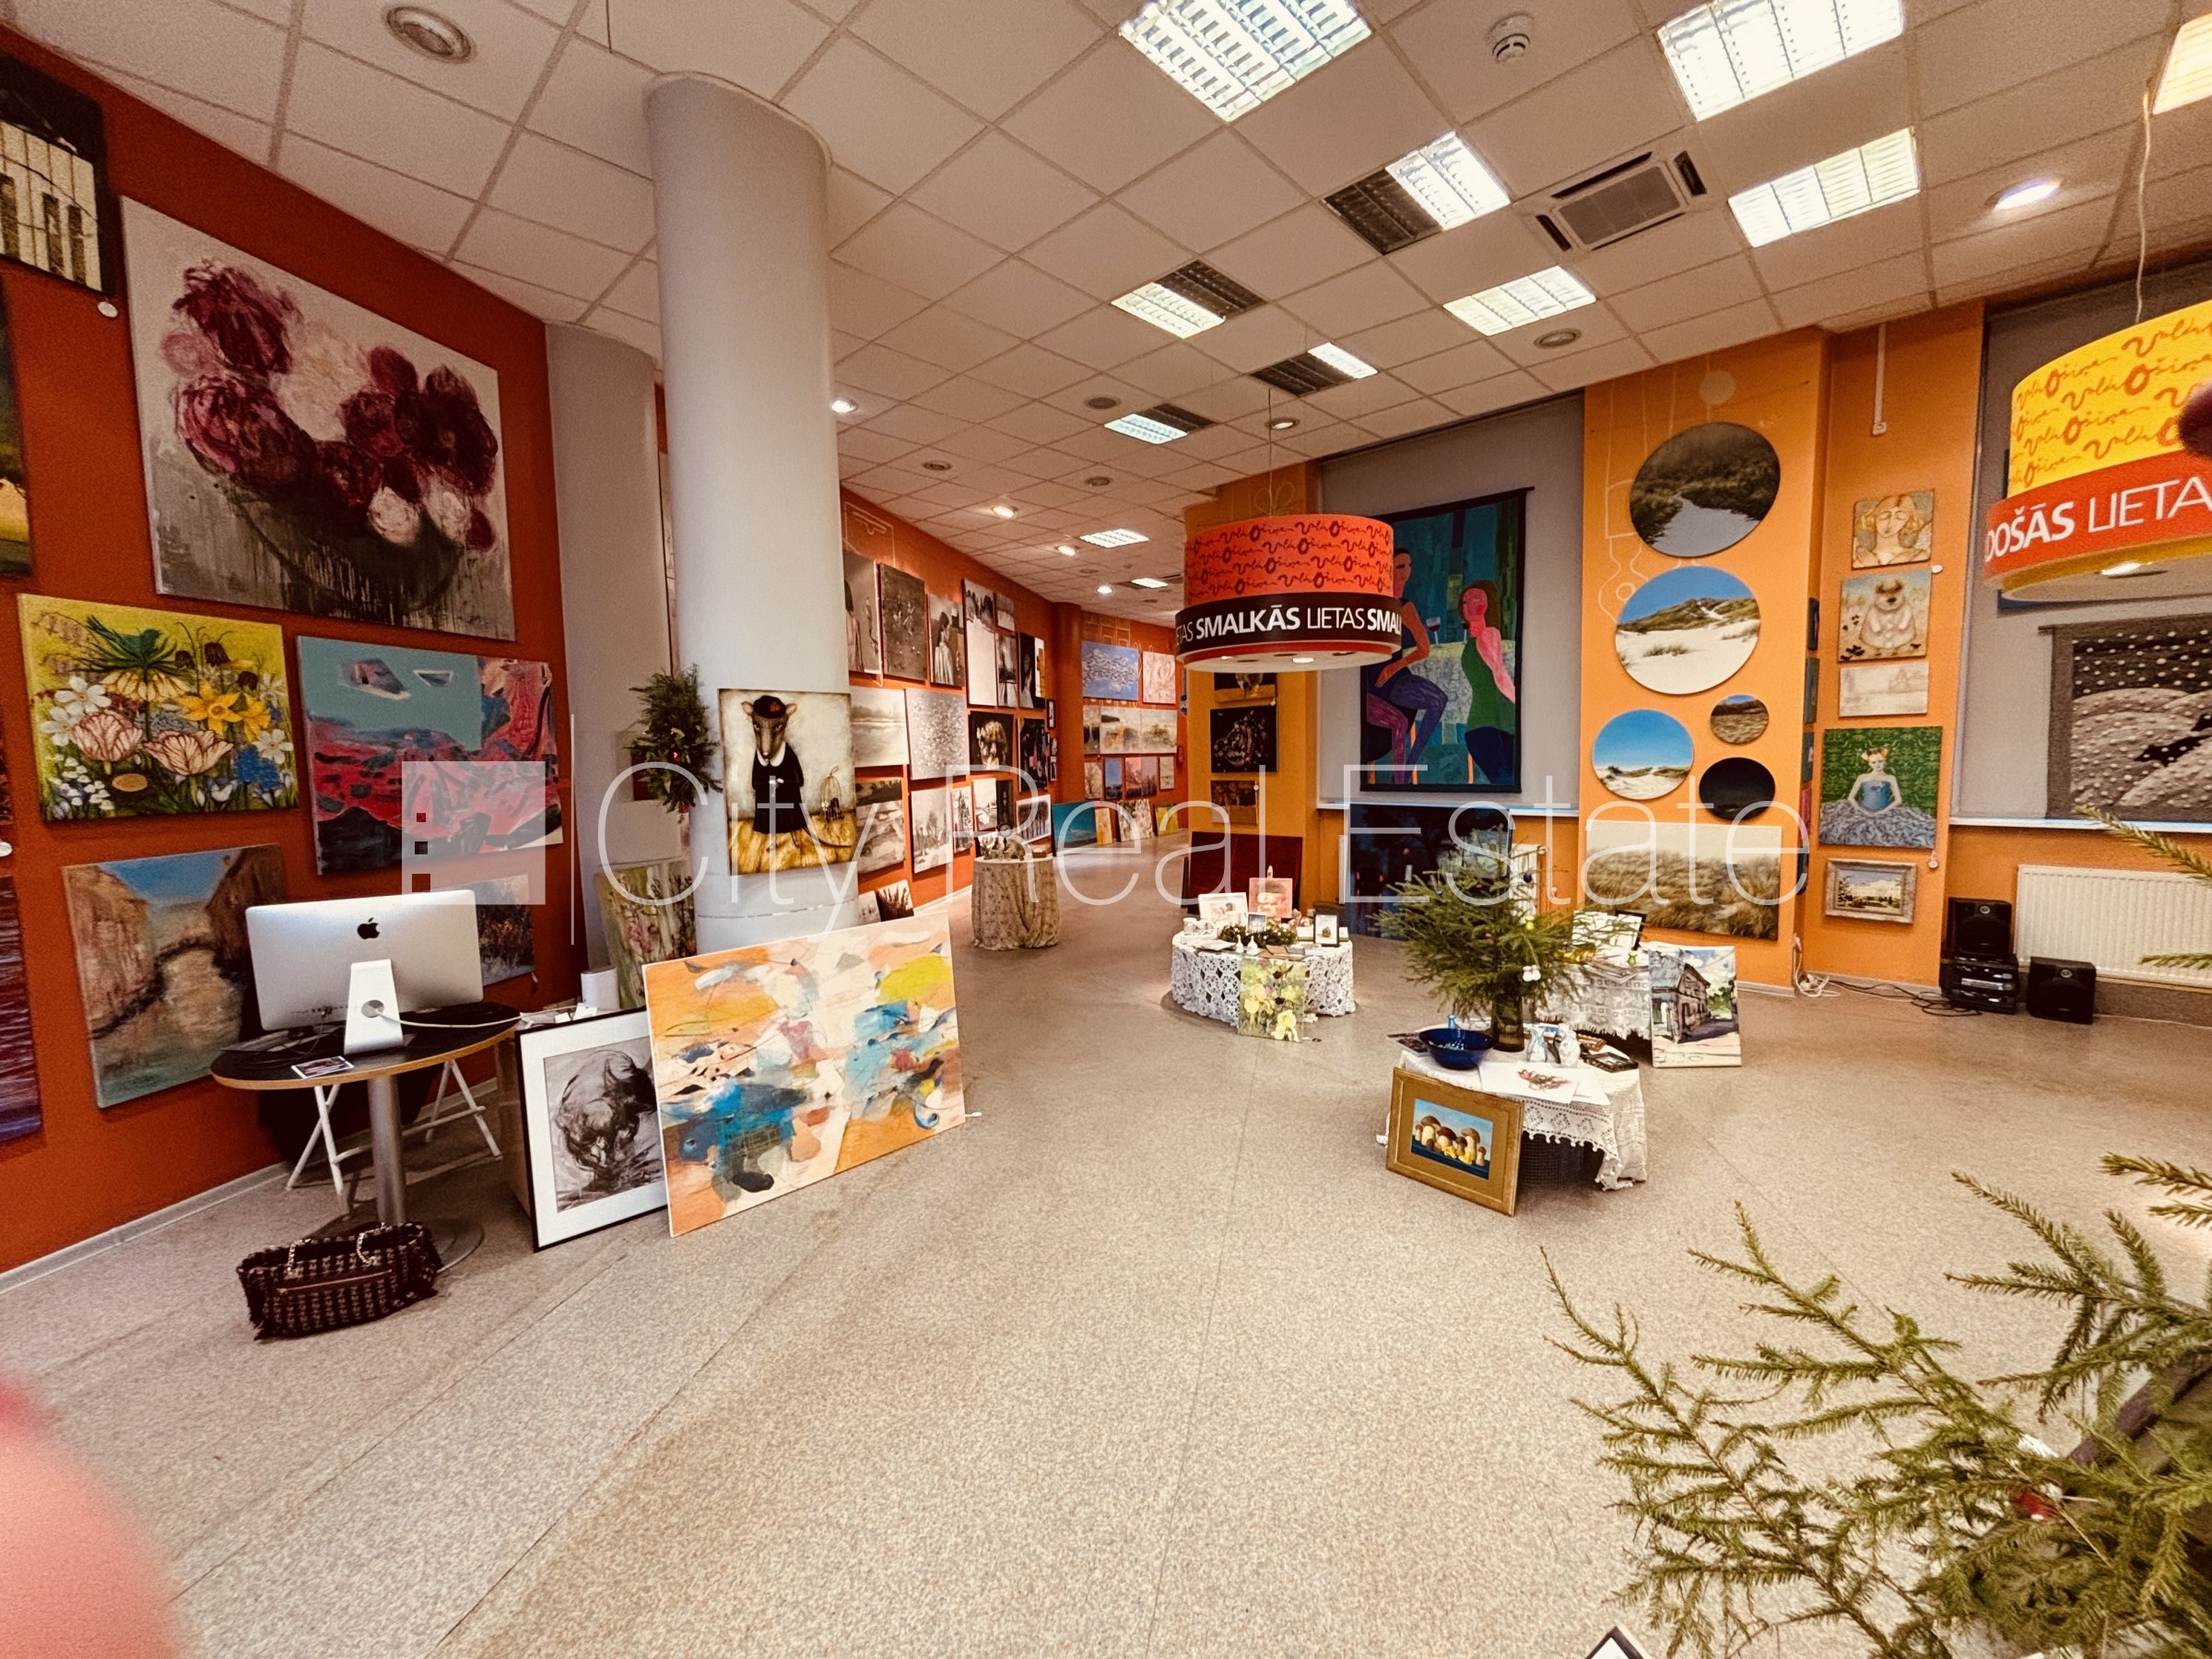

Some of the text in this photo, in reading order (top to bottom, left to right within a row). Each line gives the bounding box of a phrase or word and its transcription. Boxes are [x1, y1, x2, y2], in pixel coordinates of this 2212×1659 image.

[2088, 476, 2212, 534] LIETA
[1196, 605, 1300, 640] SMALKĀS
[1307, 607, 1364, 629] LIETAS
[1367, 608, 1402, 636] SMAL
